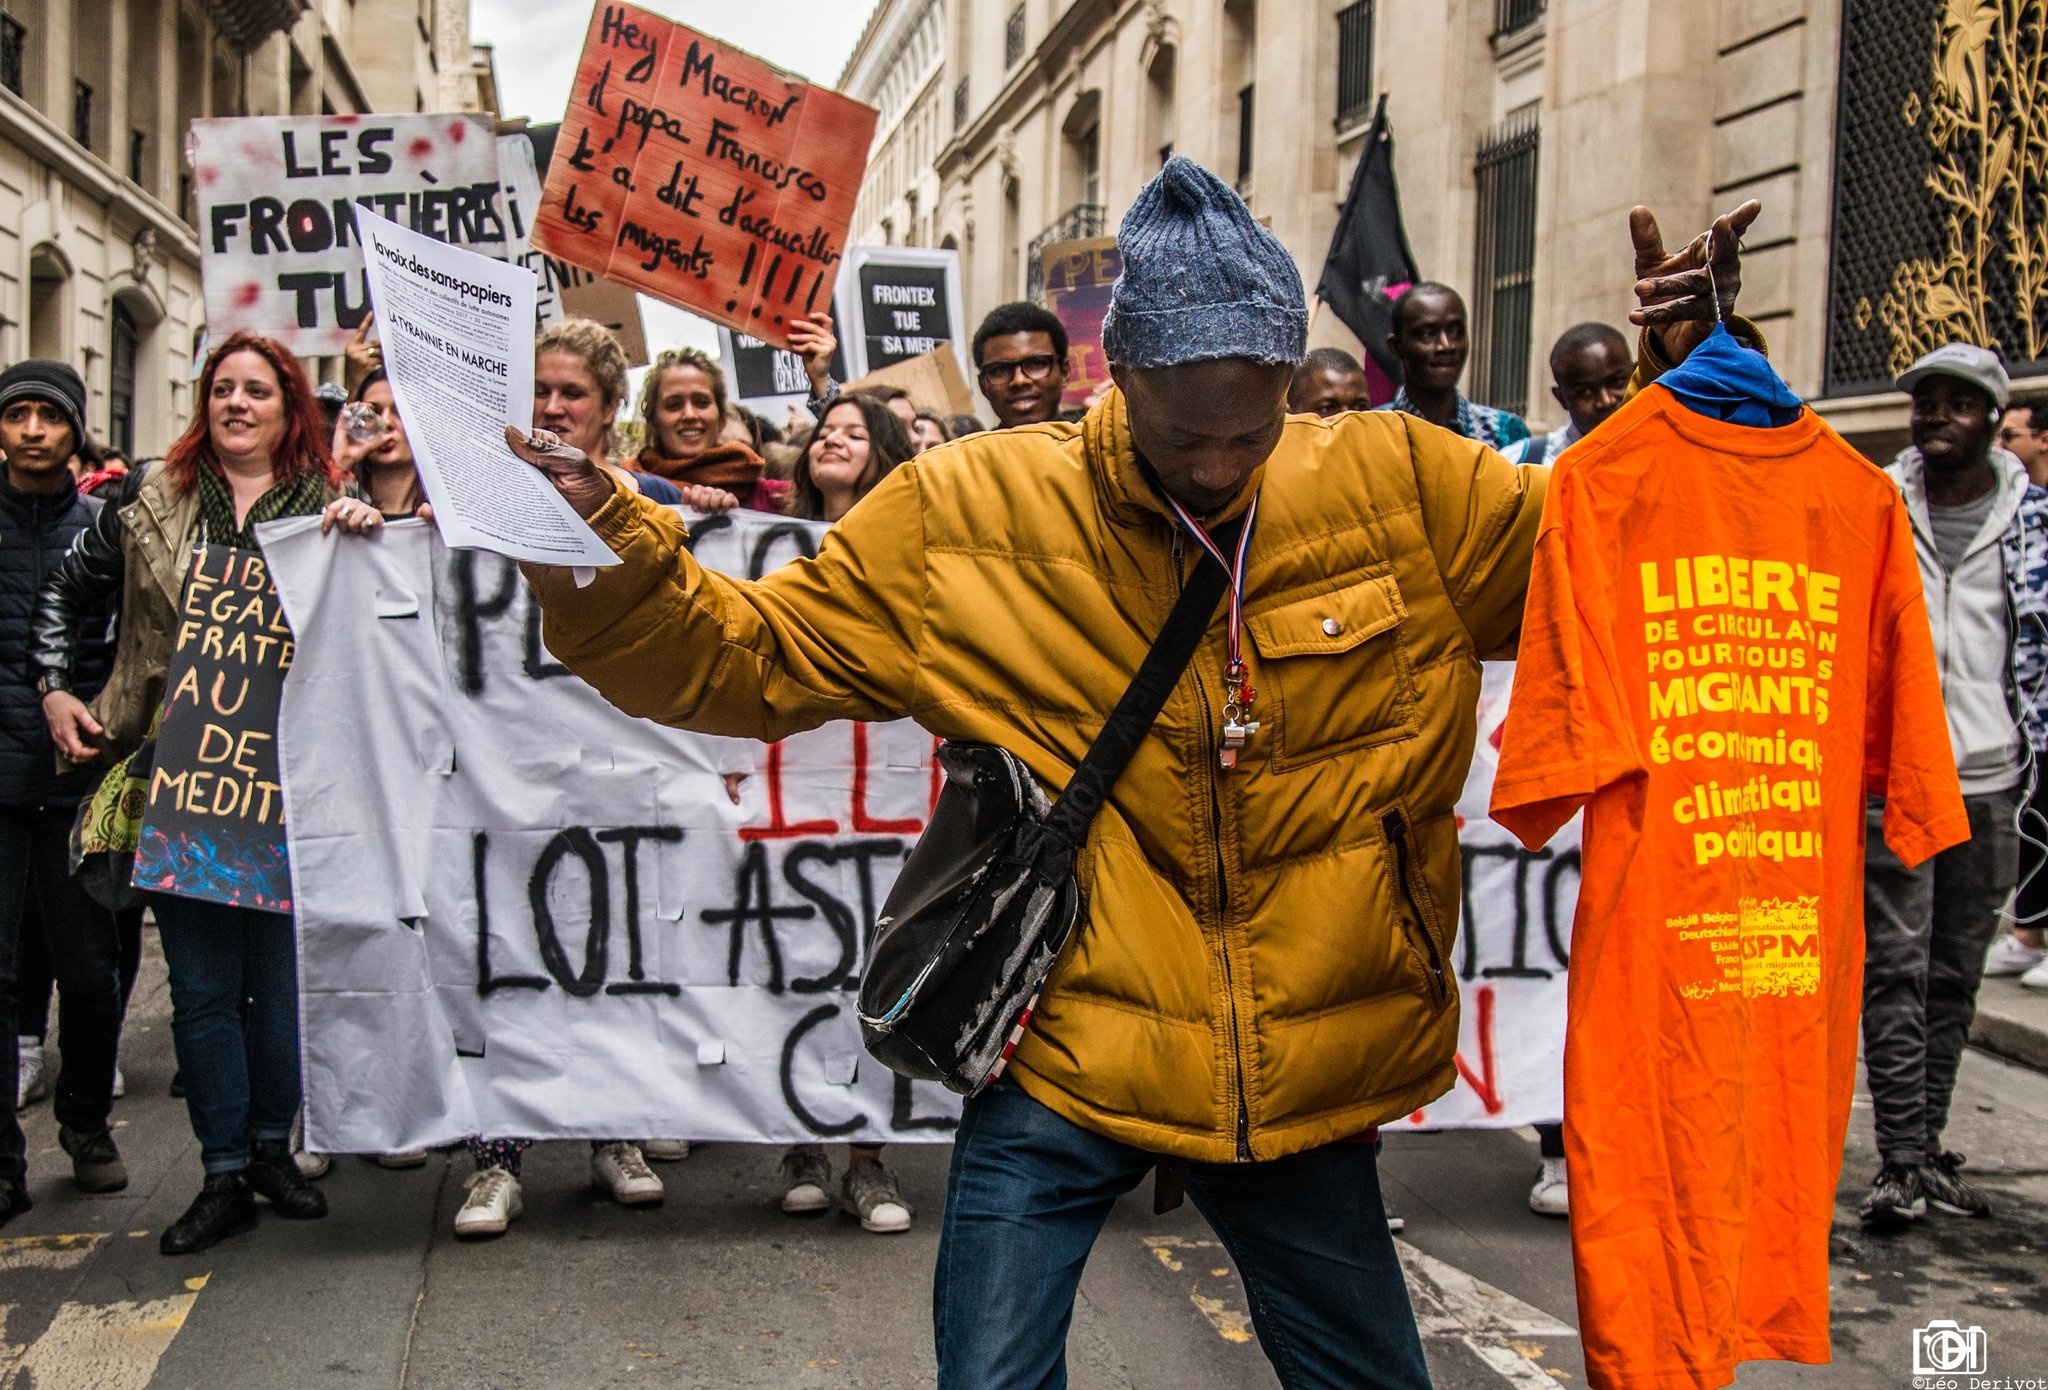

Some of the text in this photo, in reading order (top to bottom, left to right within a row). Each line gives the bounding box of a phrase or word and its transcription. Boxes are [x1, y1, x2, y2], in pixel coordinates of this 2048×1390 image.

[601, 6, 656, 83] Hey
[282, 128, 394, 178] LES
[616, 98, 690, 151] papa
[706, 118, 826, 201] Francisco
[657, 160, 704, 217] dit
[617, 220, 713, 278] migrants
[384, 243, 408, 270] voix
[409, 254, 430, 279] des
[430, 272, 512, 309] sans-papiers
[874, 284, 936, 306] FRONTEX
[387, 308, 398, 325] LA
[398, 316, 444, 353] TYRANNIE
[446, 342, 459, 359] EN
[461, 351, 508, 378] MARCHE
[882, 335, 935, 354] SA MER
[892, 311, 921, 331] TUE
[1645, 619, 1680, 644] DE
[1647, 642, 1733, 673] POUR
[198, 724, 272, 772] DE
